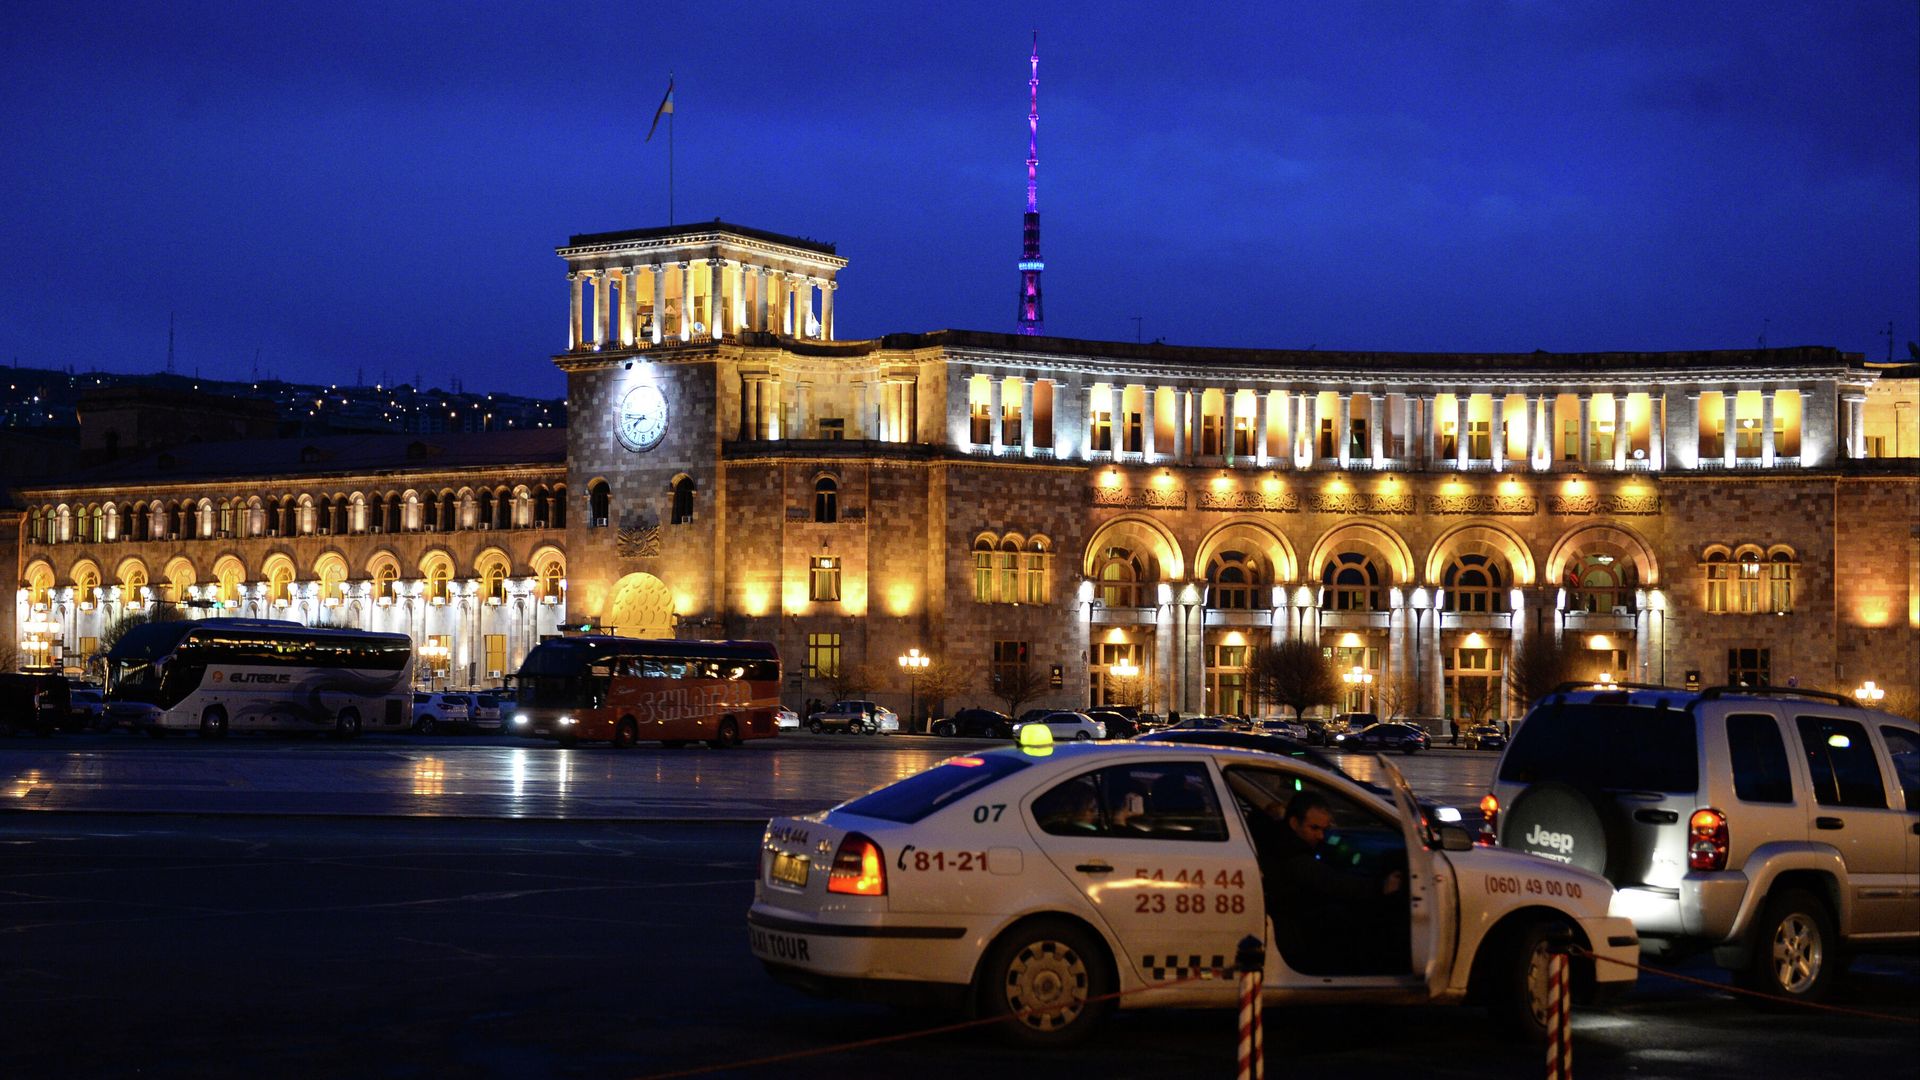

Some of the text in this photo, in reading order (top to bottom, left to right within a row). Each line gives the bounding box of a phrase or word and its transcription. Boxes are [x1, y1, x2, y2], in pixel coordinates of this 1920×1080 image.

[229, 673, 291, 684] ELITEBUS
[973, 804, 1007, 823] 07
[1526, 824, 1575, 854] Jeep
[914, 851, 987, 871] 81-21
[1175, 869, 1206, 889] 44
[1214, 869, 1245, 889] 44
[1485, 874, 1582, 898] (060) 49 00 00
[1135, 893, 1245, 914] 23 88 88
[769, 934, 810, 961] TOUR
